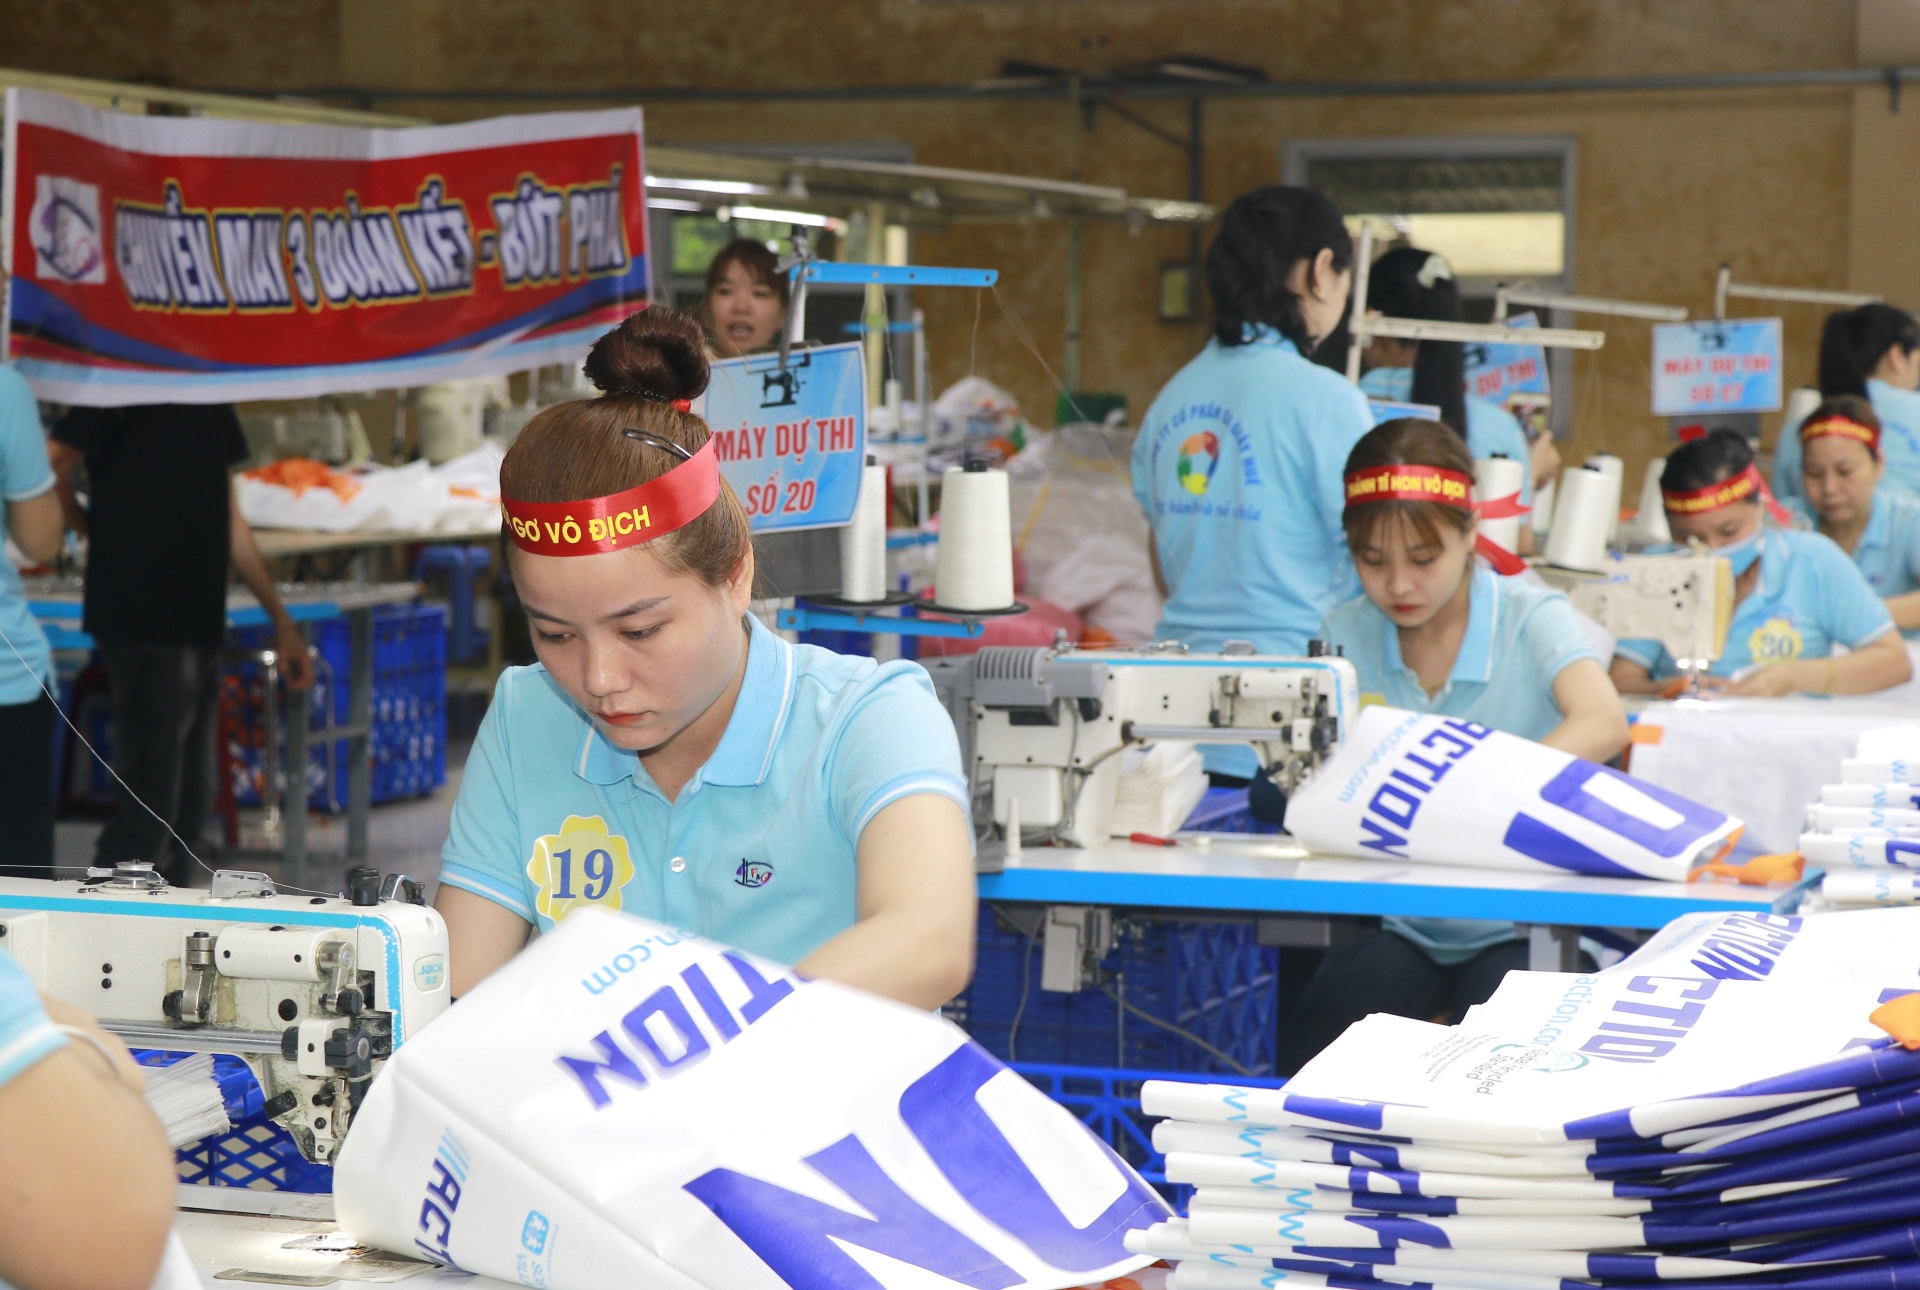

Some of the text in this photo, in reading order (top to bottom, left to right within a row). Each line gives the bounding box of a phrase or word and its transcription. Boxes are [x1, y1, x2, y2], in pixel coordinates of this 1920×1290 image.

[211, 207, 296, 314] MAY
[286, 207, 324, 313] 3
[393, 173, 474, 301] KẾT
[563, 161, 631, 283] PHÁ
[714, 417, 855, 463] MÁY DỰ THI
[746, 470, 816, 516] SỐ 20
[512, 518, 540, 542] GƠ
[545, 515, 582, 544] VÔ
[589, 505, 651, 544] ĐỊCH
[552, 848, 614, 900] 19
[552, 949, 816, 1112] TION
